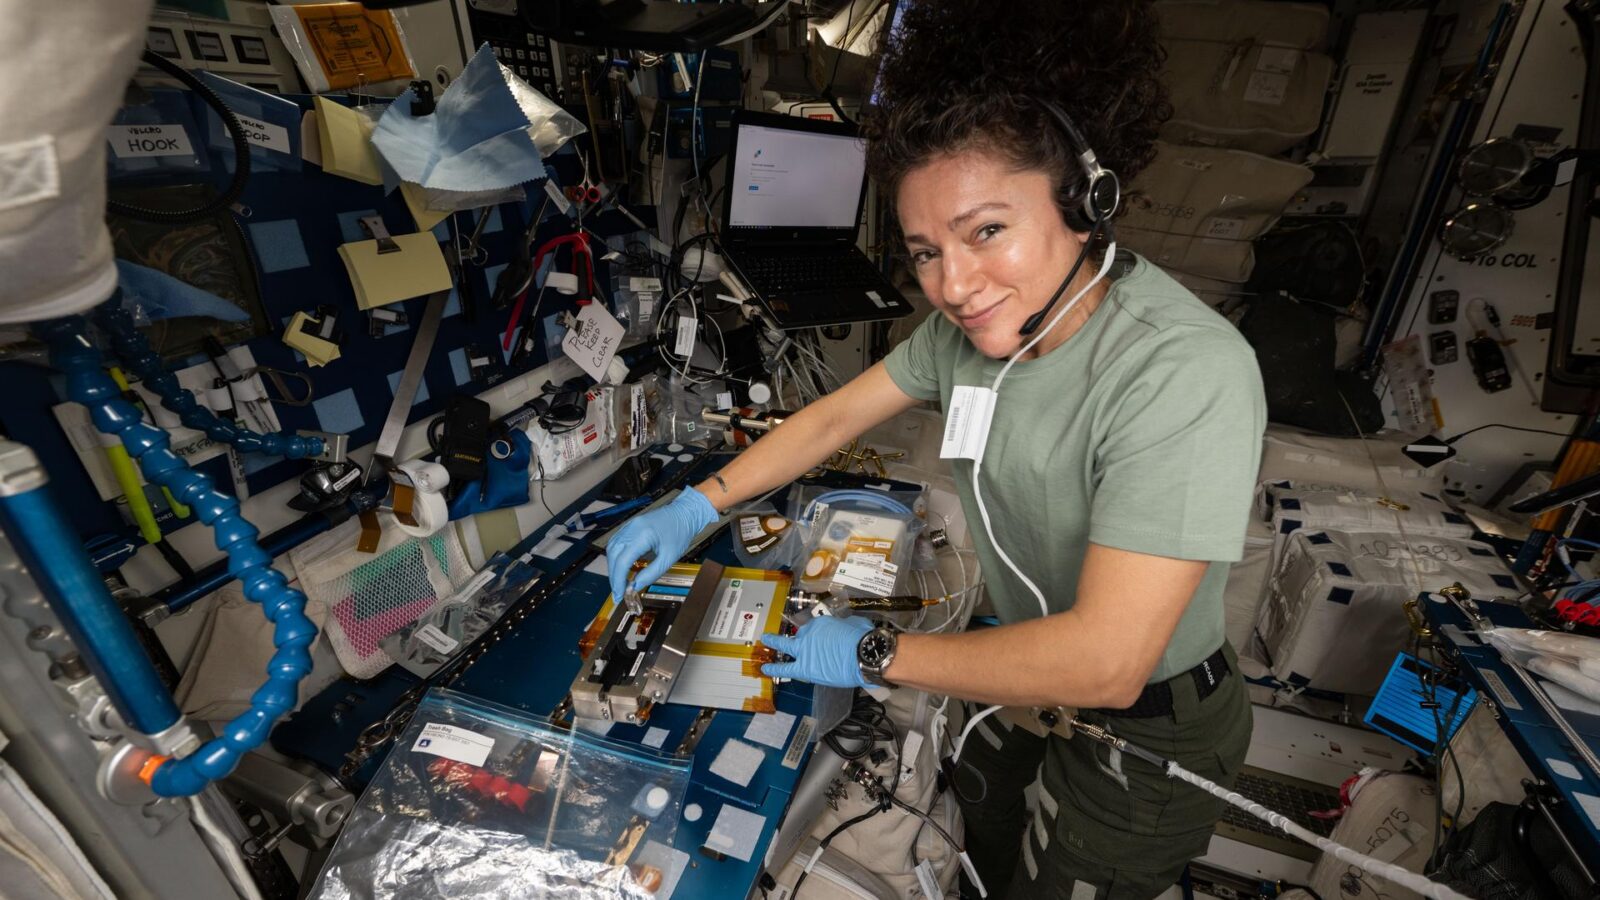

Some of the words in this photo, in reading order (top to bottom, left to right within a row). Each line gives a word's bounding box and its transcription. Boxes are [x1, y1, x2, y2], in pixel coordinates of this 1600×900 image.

[127, 139, 180, 153] HOOK
[243, 129, 271, 142] OOP
[1501, 253, 1537, 268] COL
[567, 316, 599, 354] PLEASE
[585, 327, 601, 352] KEEP
[592, 336, 614, 368] CLEAR
[1202, 660, 1216, 686] RCADE
